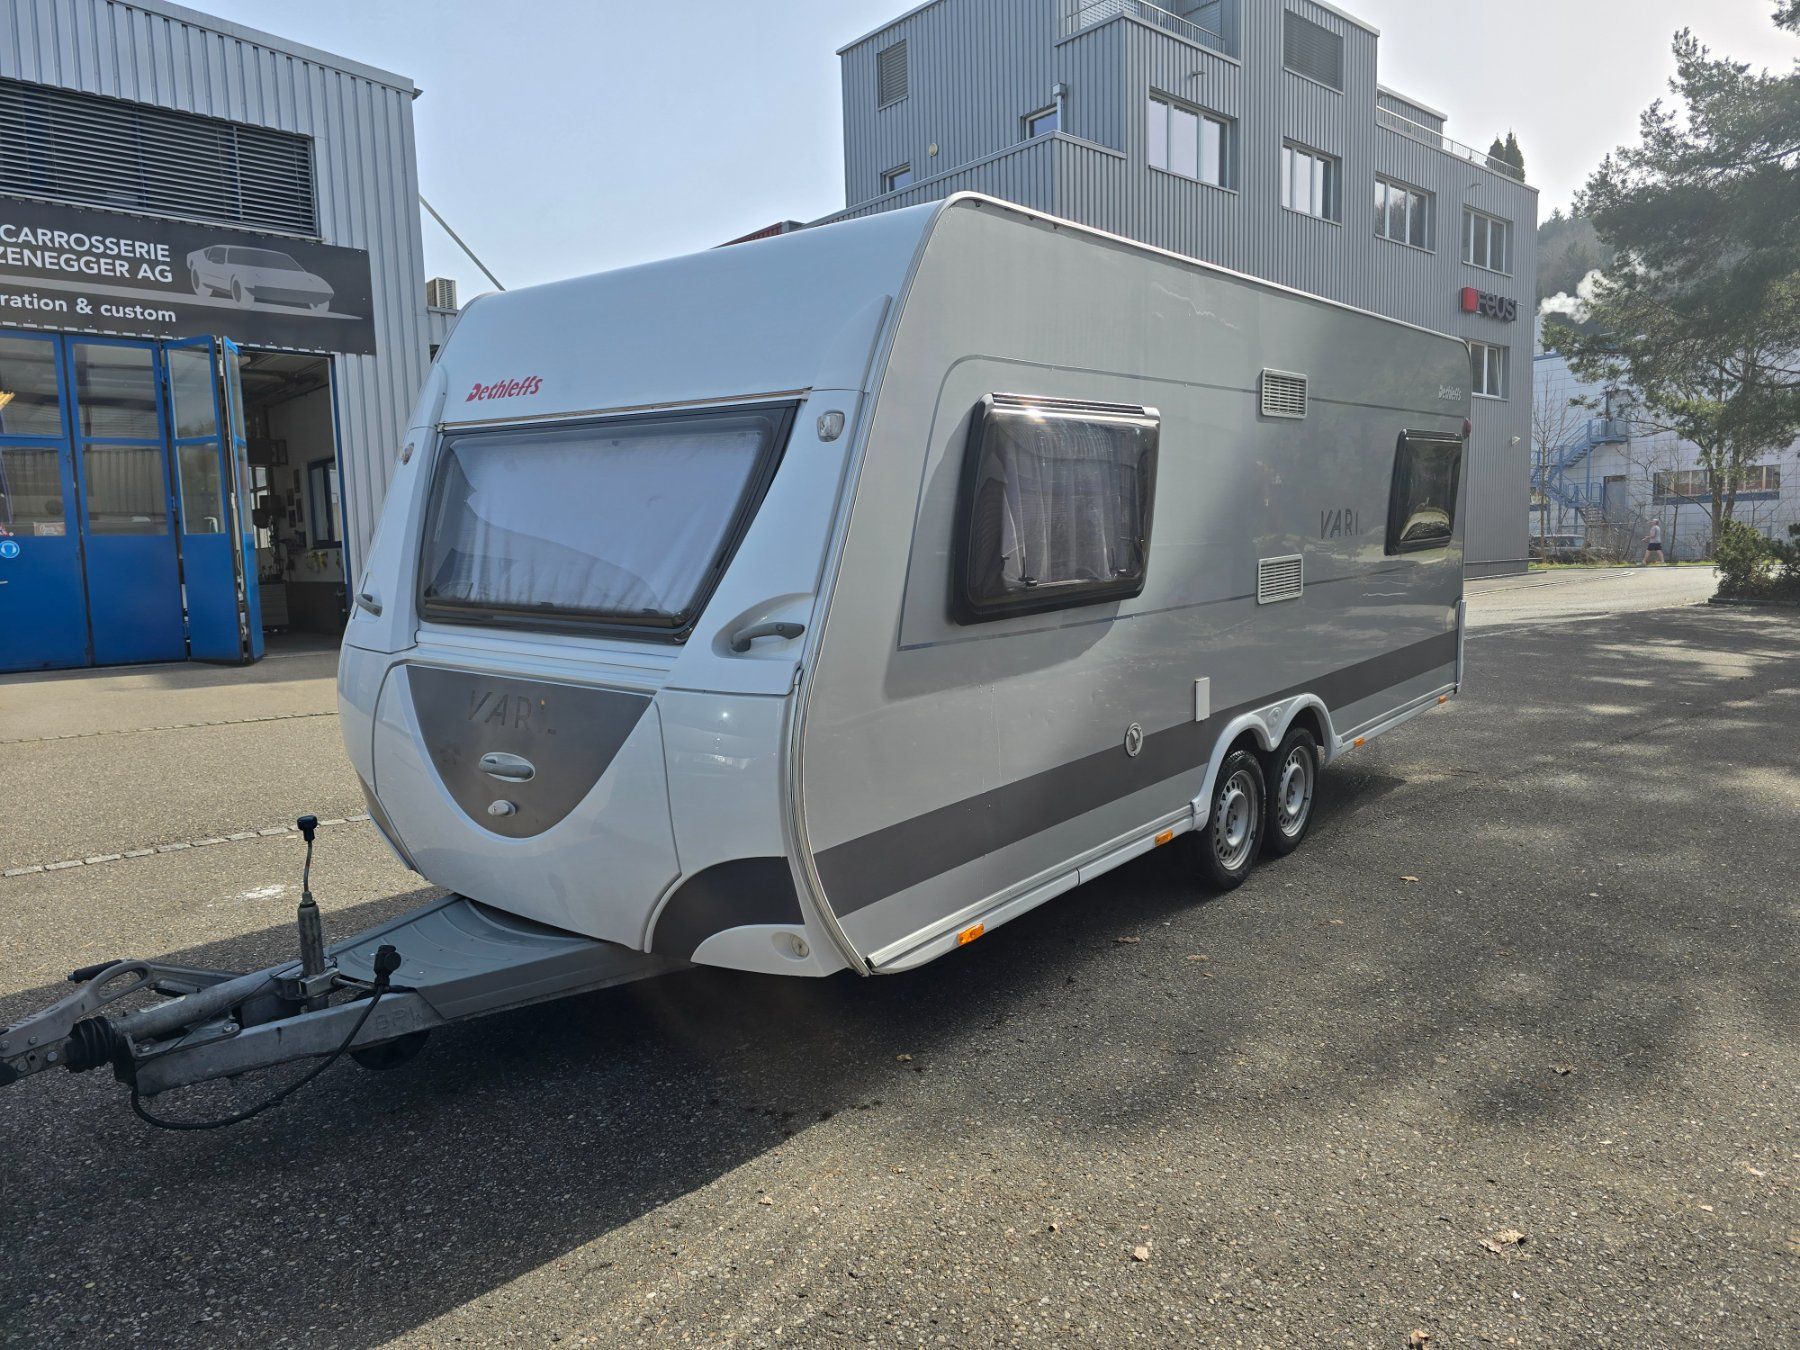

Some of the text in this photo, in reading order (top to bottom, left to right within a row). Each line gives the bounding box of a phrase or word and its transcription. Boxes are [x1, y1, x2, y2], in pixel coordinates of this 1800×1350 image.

[0, 224, 171, 262] CARROSSERIE
[137, 263, 173, 283] AG
[0, 293, 177, 323] ration & custom
[468, 690, 546, 729] VAR
